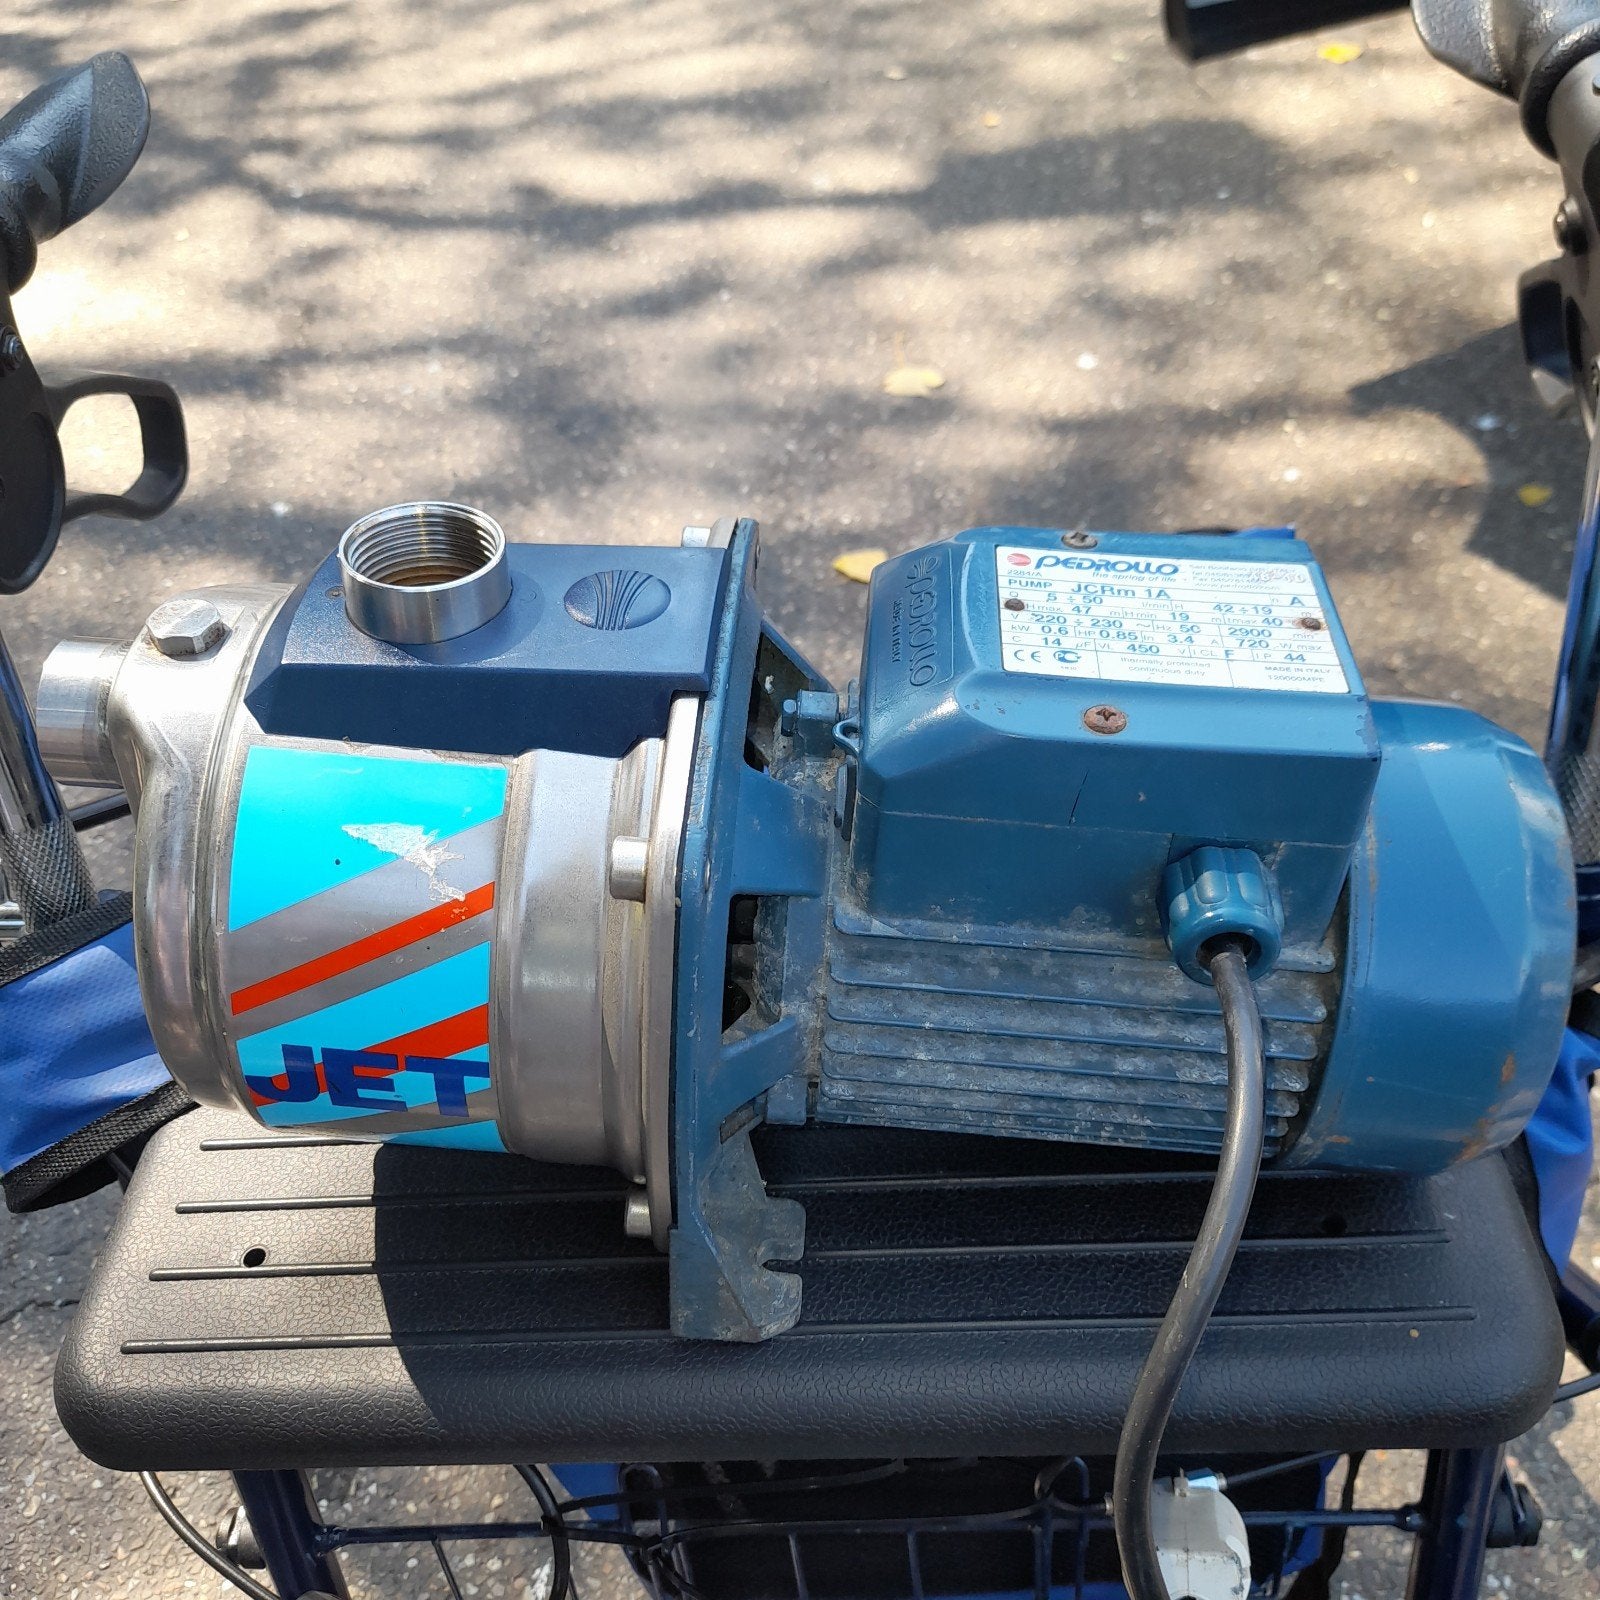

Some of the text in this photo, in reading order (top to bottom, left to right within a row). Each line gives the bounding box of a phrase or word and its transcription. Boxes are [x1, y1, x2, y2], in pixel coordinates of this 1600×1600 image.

[1034, 555, 1179, 576] PEDROLLO
[1112, 574, 1145, 582] spring
[1008, 579, 1171, 599] PUMP JCRm 1A
[1046, 592, 1057, 602] 5
[1082, 595, 1103, 605] 50
[1289, 596, 1305, 606] A
[1071, 605, 1092, 615] 47
[1212, 604, 1235, 614] 42
[1253, 606, 1272, 615] 19
[1034, 613, 1067, 625] 220
[1090, 618, 1123, 629] 230
[1170, 612, 1190, 621] 19
[1261, 617, 1283, 627] 40
[1011, 624, 1069, 636] kW 0.6
[1156, 624, 1201, 634] Hz 50
[1228, 627, 1272, 638] 2900
[1077, 629, 1138, 641] HP 0.85
[1167, 634, 1195, 645] 3.4
[1012, 635, 1022, 643] C
[1042, 637, 1063, 647] 14
[1235, 638, 1270, 649] 720
[1126, 644, 1160, 654] 450
[1225, 650, 1235, 659] F
[1120, 656, 1211, 668] thermally protected
[1284, 653, 1307, 662] 44
[1128, 666, 1206, 677] continuous duty
[244, 1043, 490, 1118] JET
